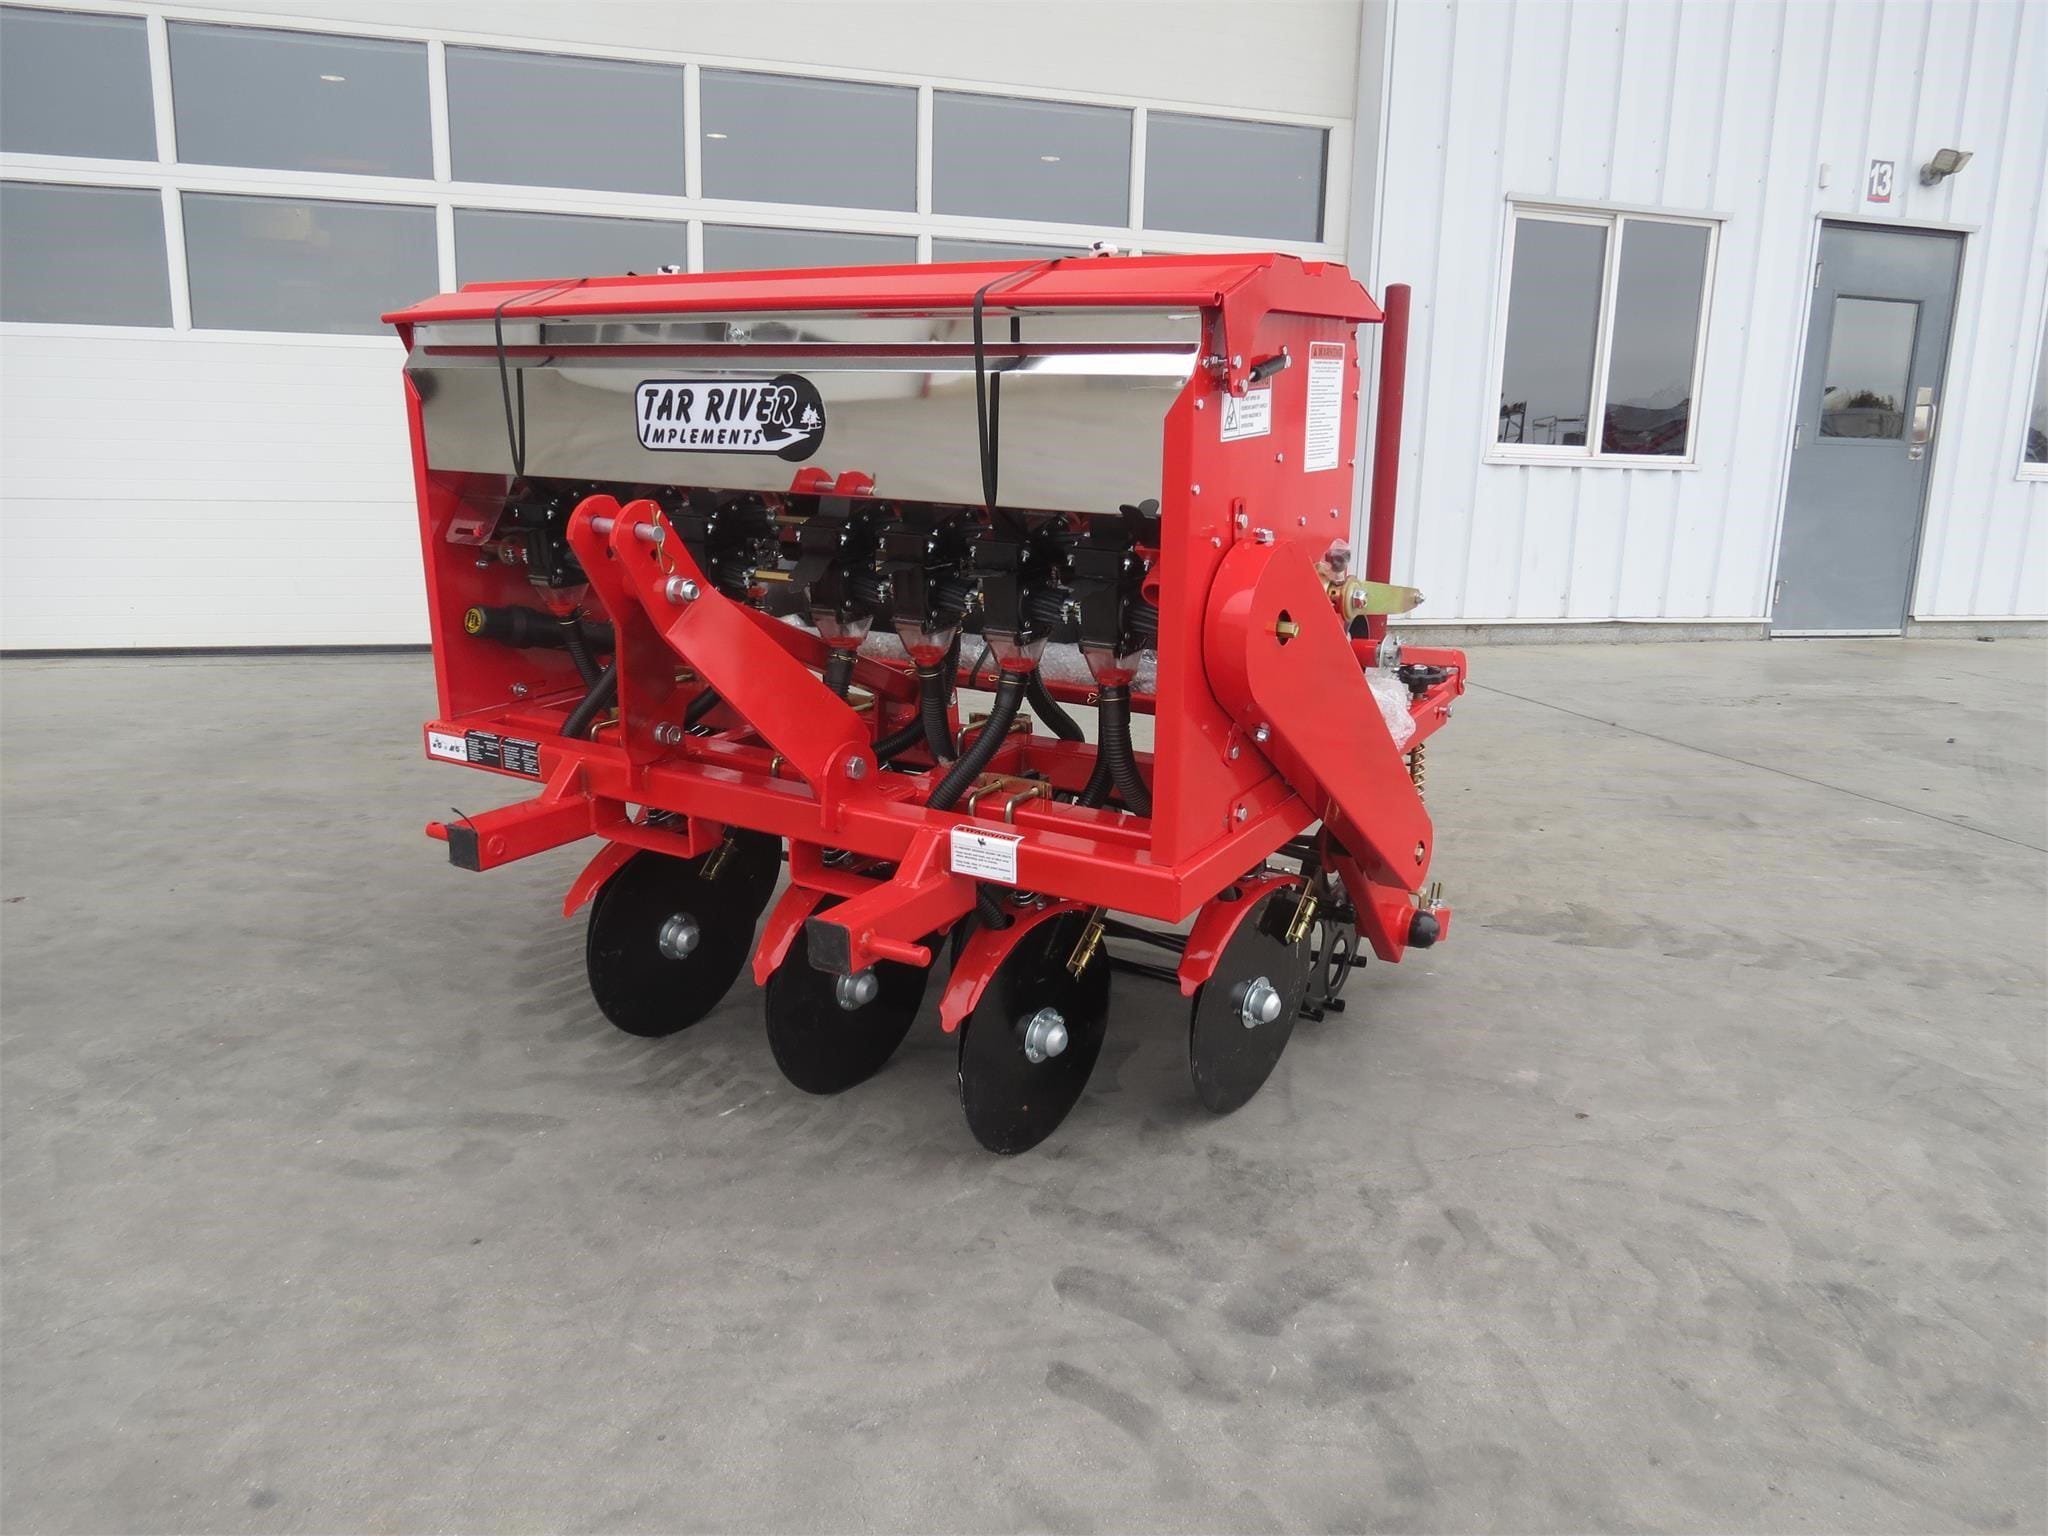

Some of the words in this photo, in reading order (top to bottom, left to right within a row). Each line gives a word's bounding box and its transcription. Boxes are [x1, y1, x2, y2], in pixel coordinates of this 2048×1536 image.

[1870, 162, 1892, 196] 13
[644, 388, 694, 424] TAR
[705, 387, 796, 426] RIVER
[643, 423, 764, 445] IMPLEMENTS
